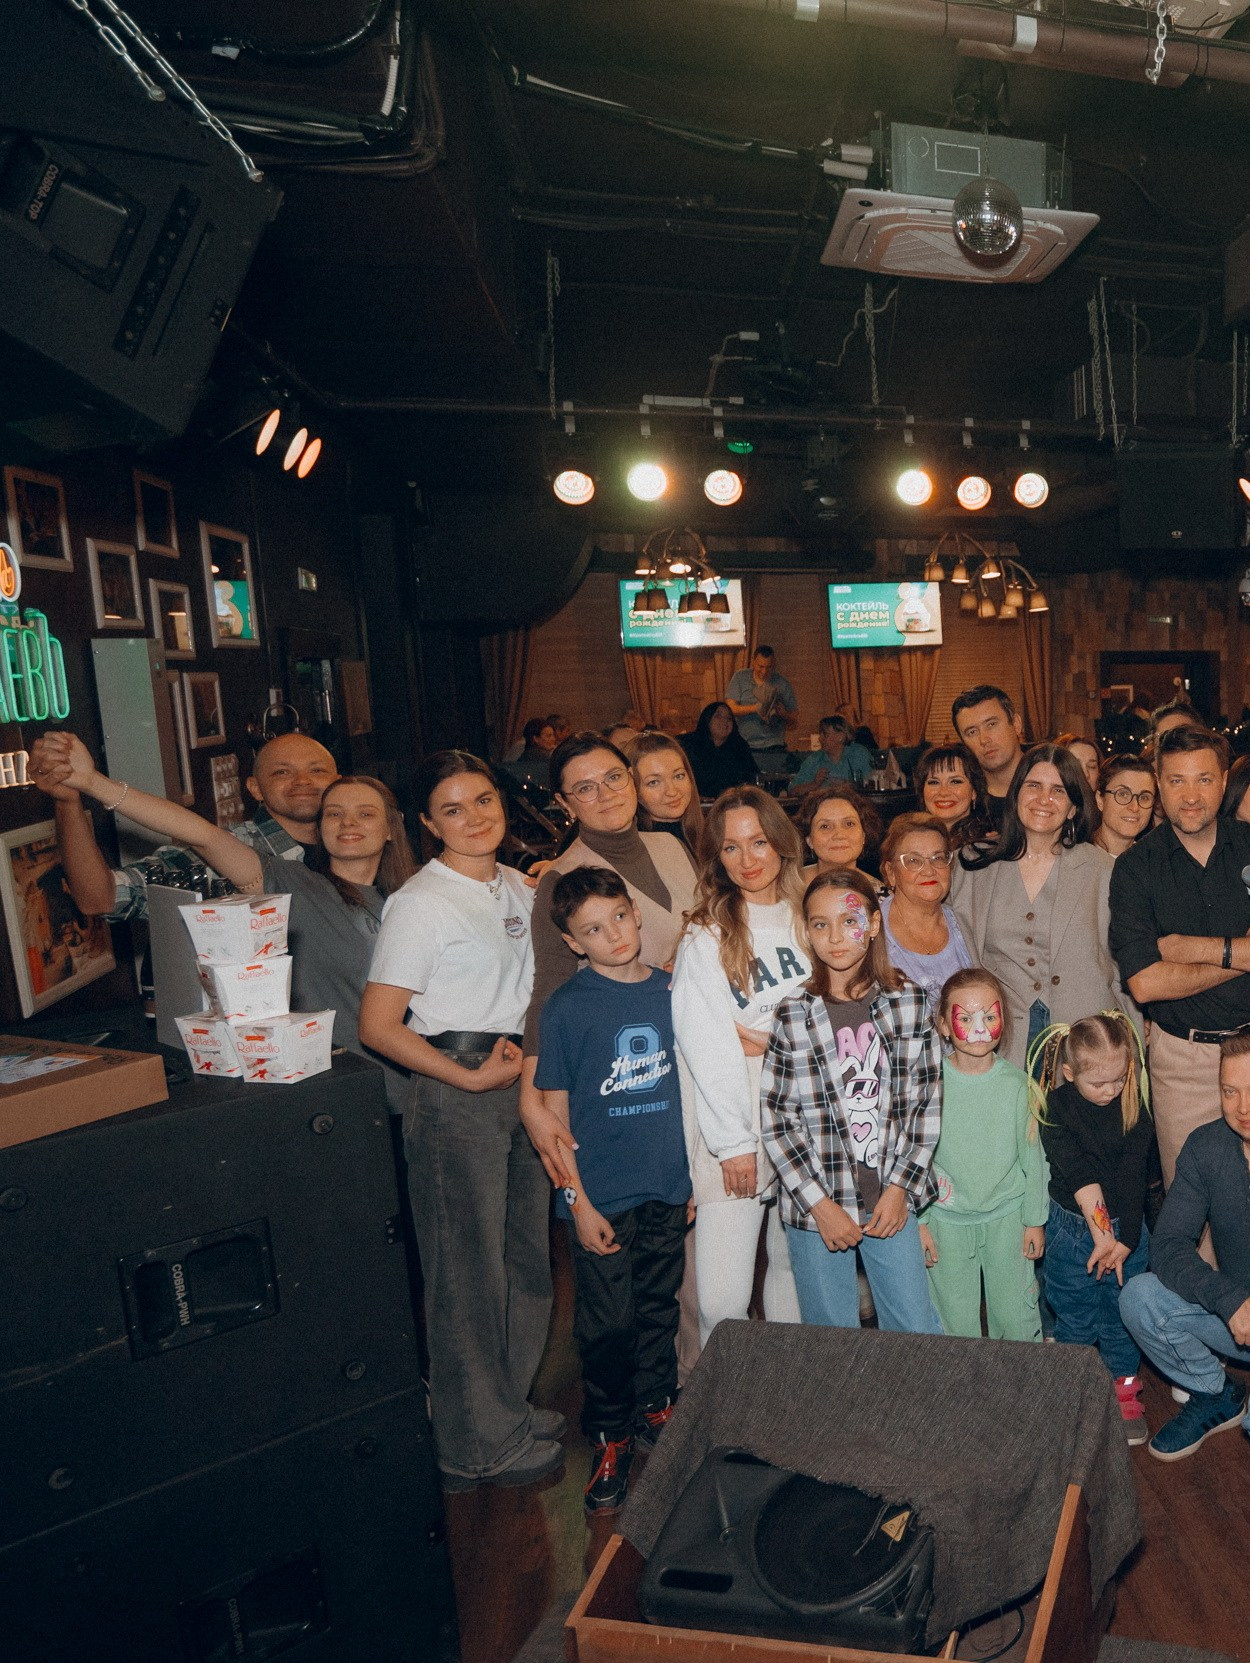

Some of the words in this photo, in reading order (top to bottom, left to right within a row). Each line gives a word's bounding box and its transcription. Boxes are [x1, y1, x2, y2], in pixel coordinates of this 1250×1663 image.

[28, 164, 59, 220] COBRA-TOP
[836, 601, 889, 611] КОКТЕЙЛЬ
[849, 611, 890, 622] днем
[196, 914, 225, 924] Raffaello
[250, 913, 287, 930] Raffaello
[237, 968, 274, 981] Raffaello
[185, 1033, 222, 1049] Raffaello
[236, 1041, 280, 1054] Raffaello
[611, 1050, 667, 1078] Human
[172, 1263, 191, 1326] COBRA-PWH
